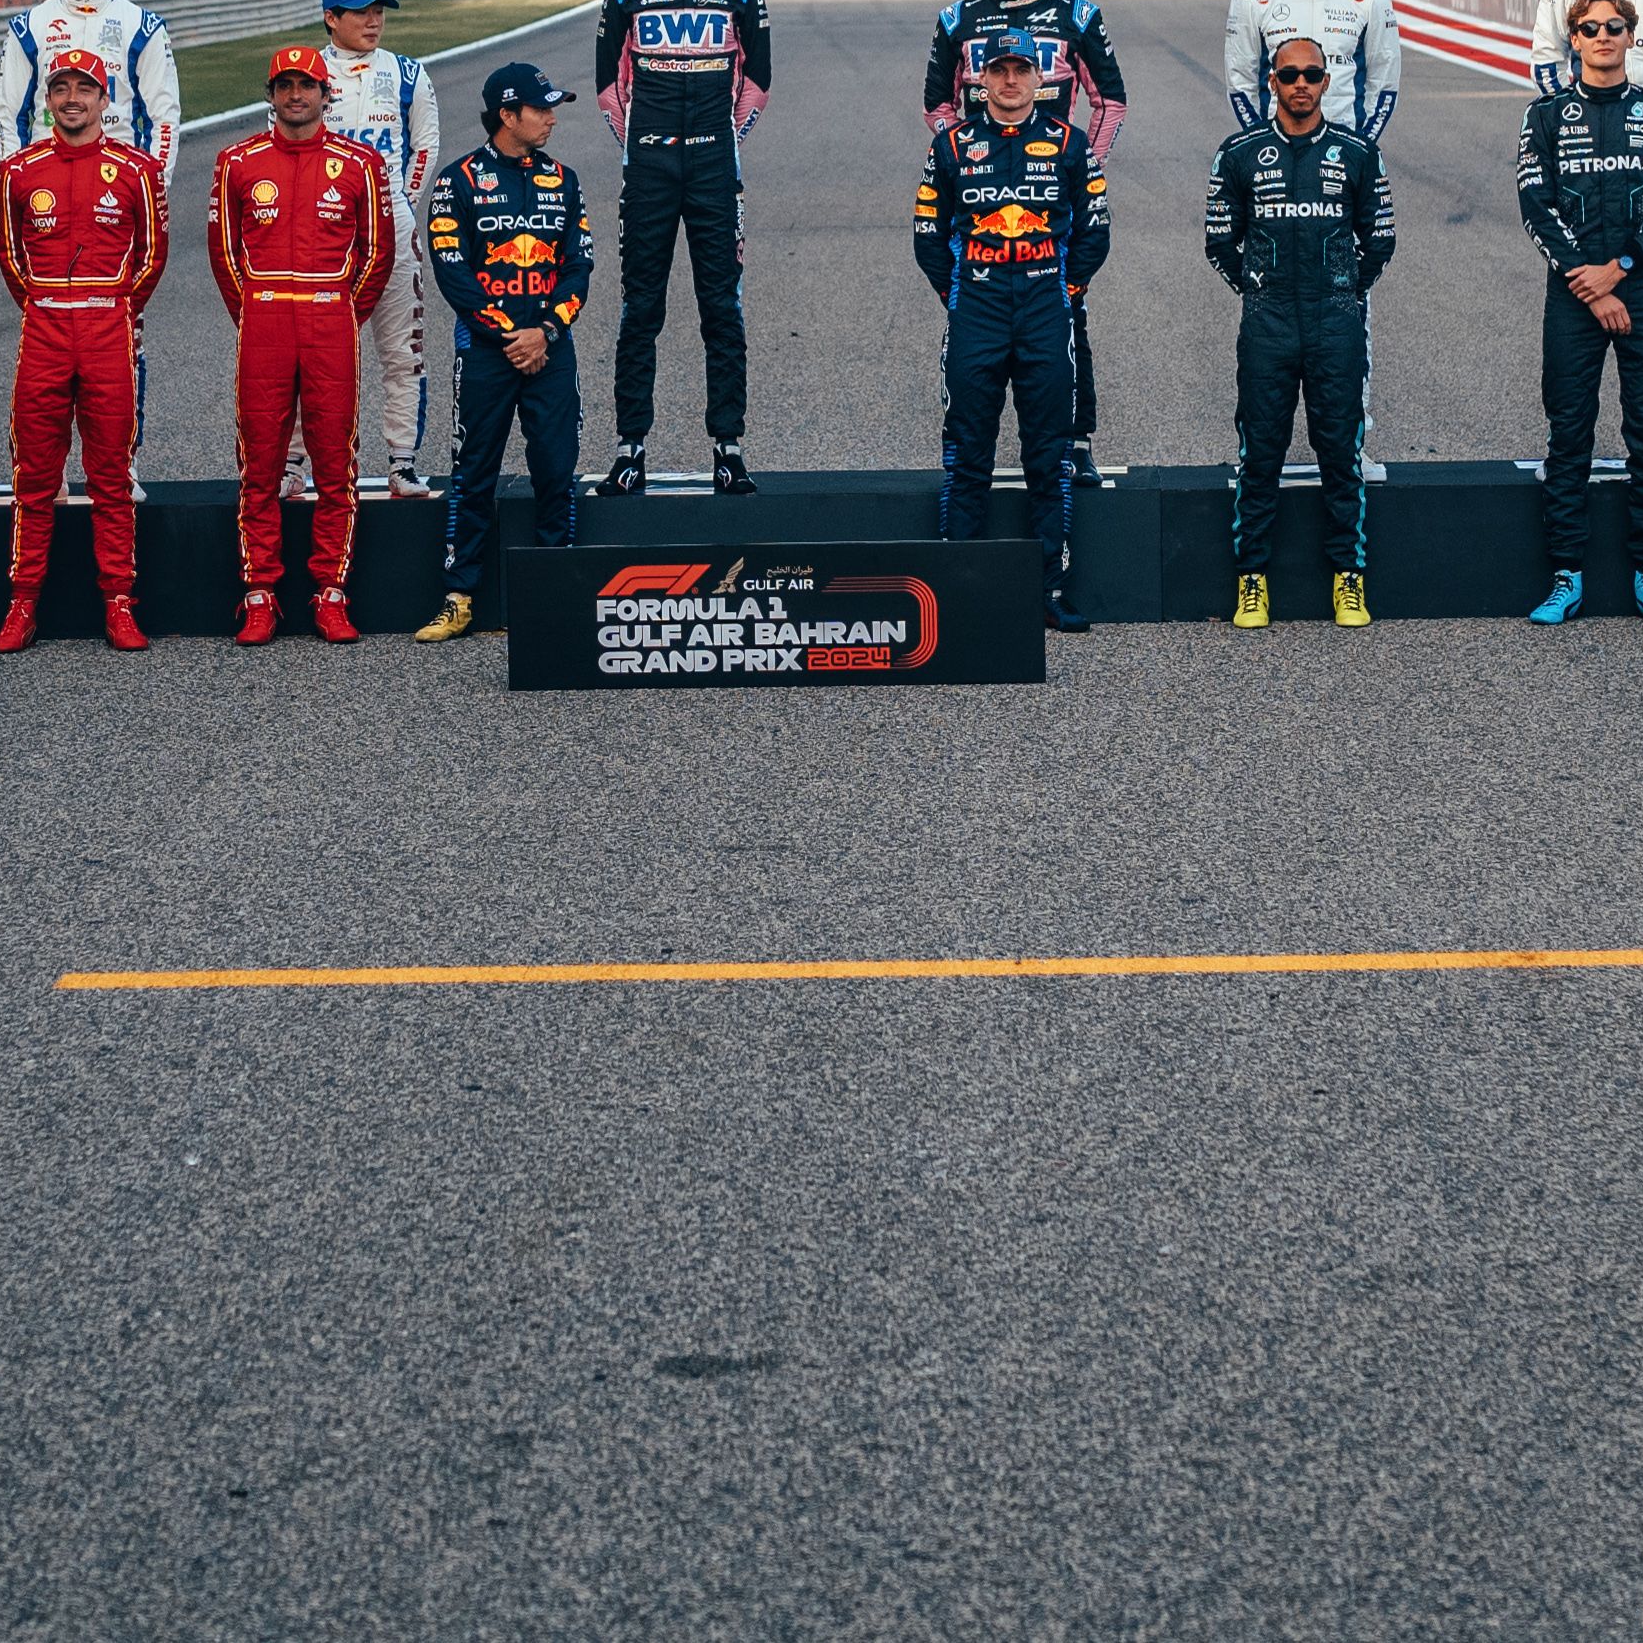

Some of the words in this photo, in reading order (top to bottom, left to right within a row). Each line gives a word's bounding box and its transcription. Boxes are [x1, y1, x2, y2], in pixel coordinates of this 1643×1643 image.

[976, 14, 1009, 23] ALPINE
[1324, 8, 1358, 18] WILLIAMS
[1327, 15, 1356, 23] RACING
[637, 12, 729, 47] BWT
[1266, 27, 1297, 36] KOMATSU
[1324, 27, 1357, 36] DURACELL
[46, 34, 71, 43] ORLEN
[650, 60, 693, 72] Castrol
[368, 114, 397, 122] HUGO
[1570, 125, 1589, 135] UBS
[685, 135, 716, 145] ESTEBAN
[158, 124, 172, 168] ORLEN
[410, 149, 429, 190] ORLEN
[960, 166, 983, 176] Mobil
[1027, 162, 1056, 173] BYBIT
[1263, 170, 1282, 179] UBS
[1319, 169, 1347, 180] INEOS
[537, 193, 565, 202] BYBIT
[962, 185, 1059, 203] ORACLE
[474, 196, 499, 205] Mobil
[253, 208, 279, 219] VGW
[1254, 202, 1343, 218] PETRONAS
[32, 217, 57, 228] VGW
[477, 215, 566, 232] ORACLE
[915, 221, 937, 233] VISA
[1206, 224, 1232, 234] nuvei
[967, 240, 1010, 263] Red
[1015, 238, 1055, 263] Bull
[1524, 219, 1560, 271] INEOS
[439, 252, 464, 263] VISA
[1040, 267, 1058, 275] MAX
[477, 270, 524, 296] Red
[766, 566, 791, 578] الخليج
[793, 565, 814, 576] طيران
[743, 579, 784, 591] GULF
[788, 579, 814, 590] AIR
[597, 596, 764, 622] FORMULA
[769, 596, 788, 619] 1
[597, 623, 682, 648] GULF
[687, 623, 745, 647] AIR
[755, 620, 907, 646] BAHRAIN
[598, 650, 718, 673] GRAND
[722, 648, 803, 672] PRIX
[808, 647, 891, 670] 2024
